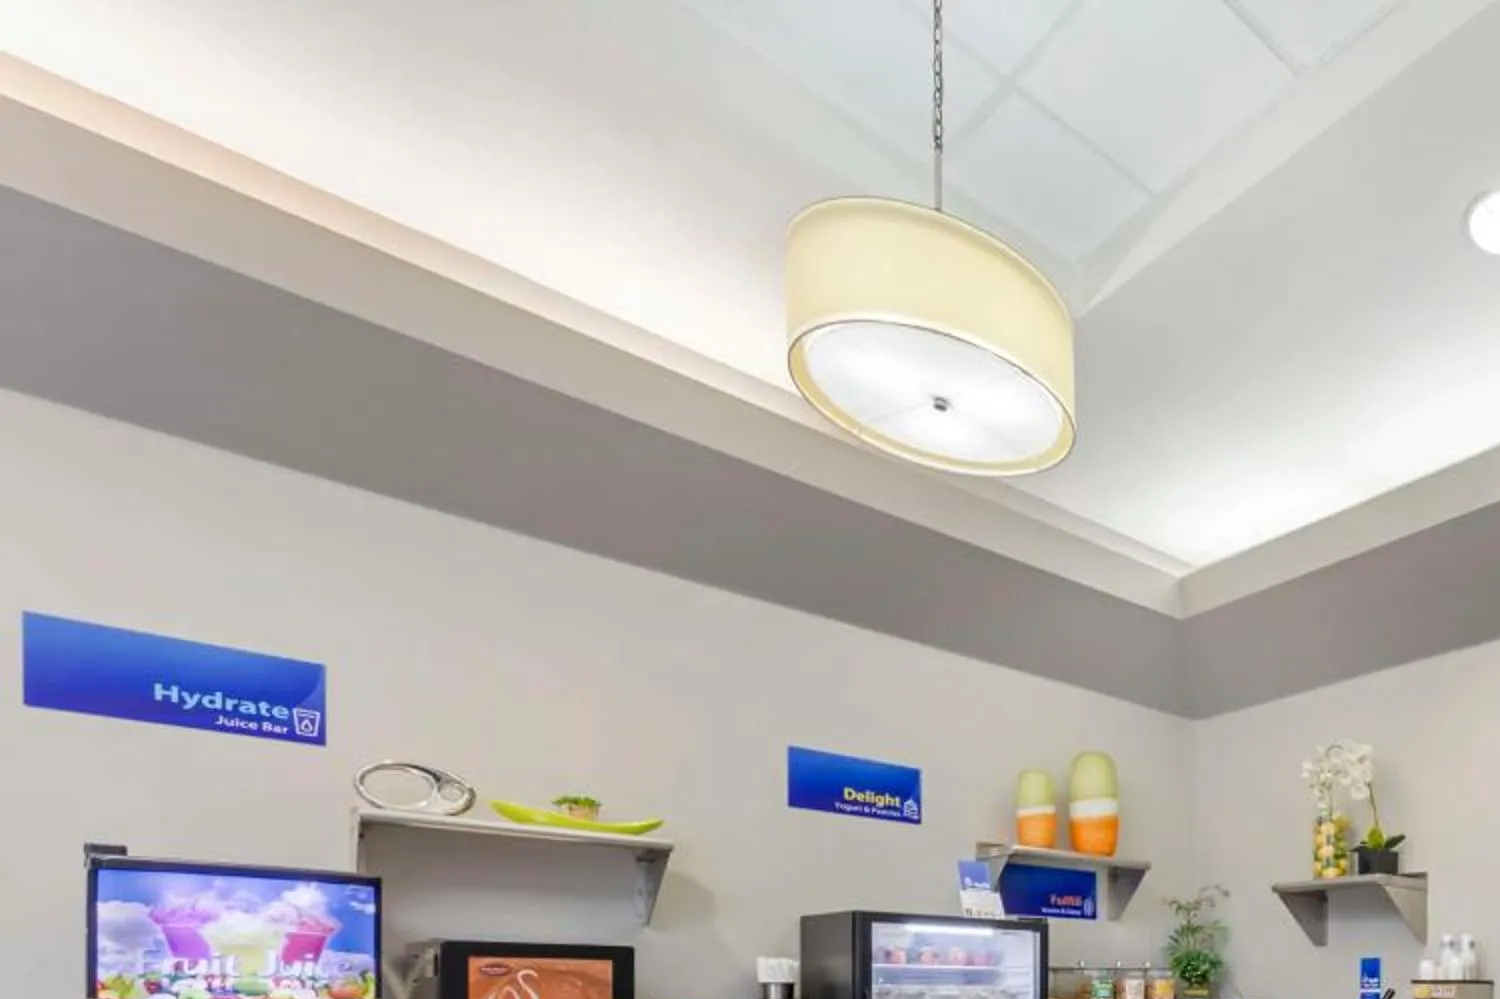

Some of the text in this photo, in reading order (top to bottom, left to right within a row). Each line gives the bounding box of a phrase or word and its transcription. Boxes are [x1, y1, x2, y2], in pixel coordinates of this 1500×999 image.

[153, 683, 289, 720] Hydrate
[215, 715, 288, 735] Juice Bar
[843, 786, 900, 807] Delight
[142, 948, 238, 976] Fruit
